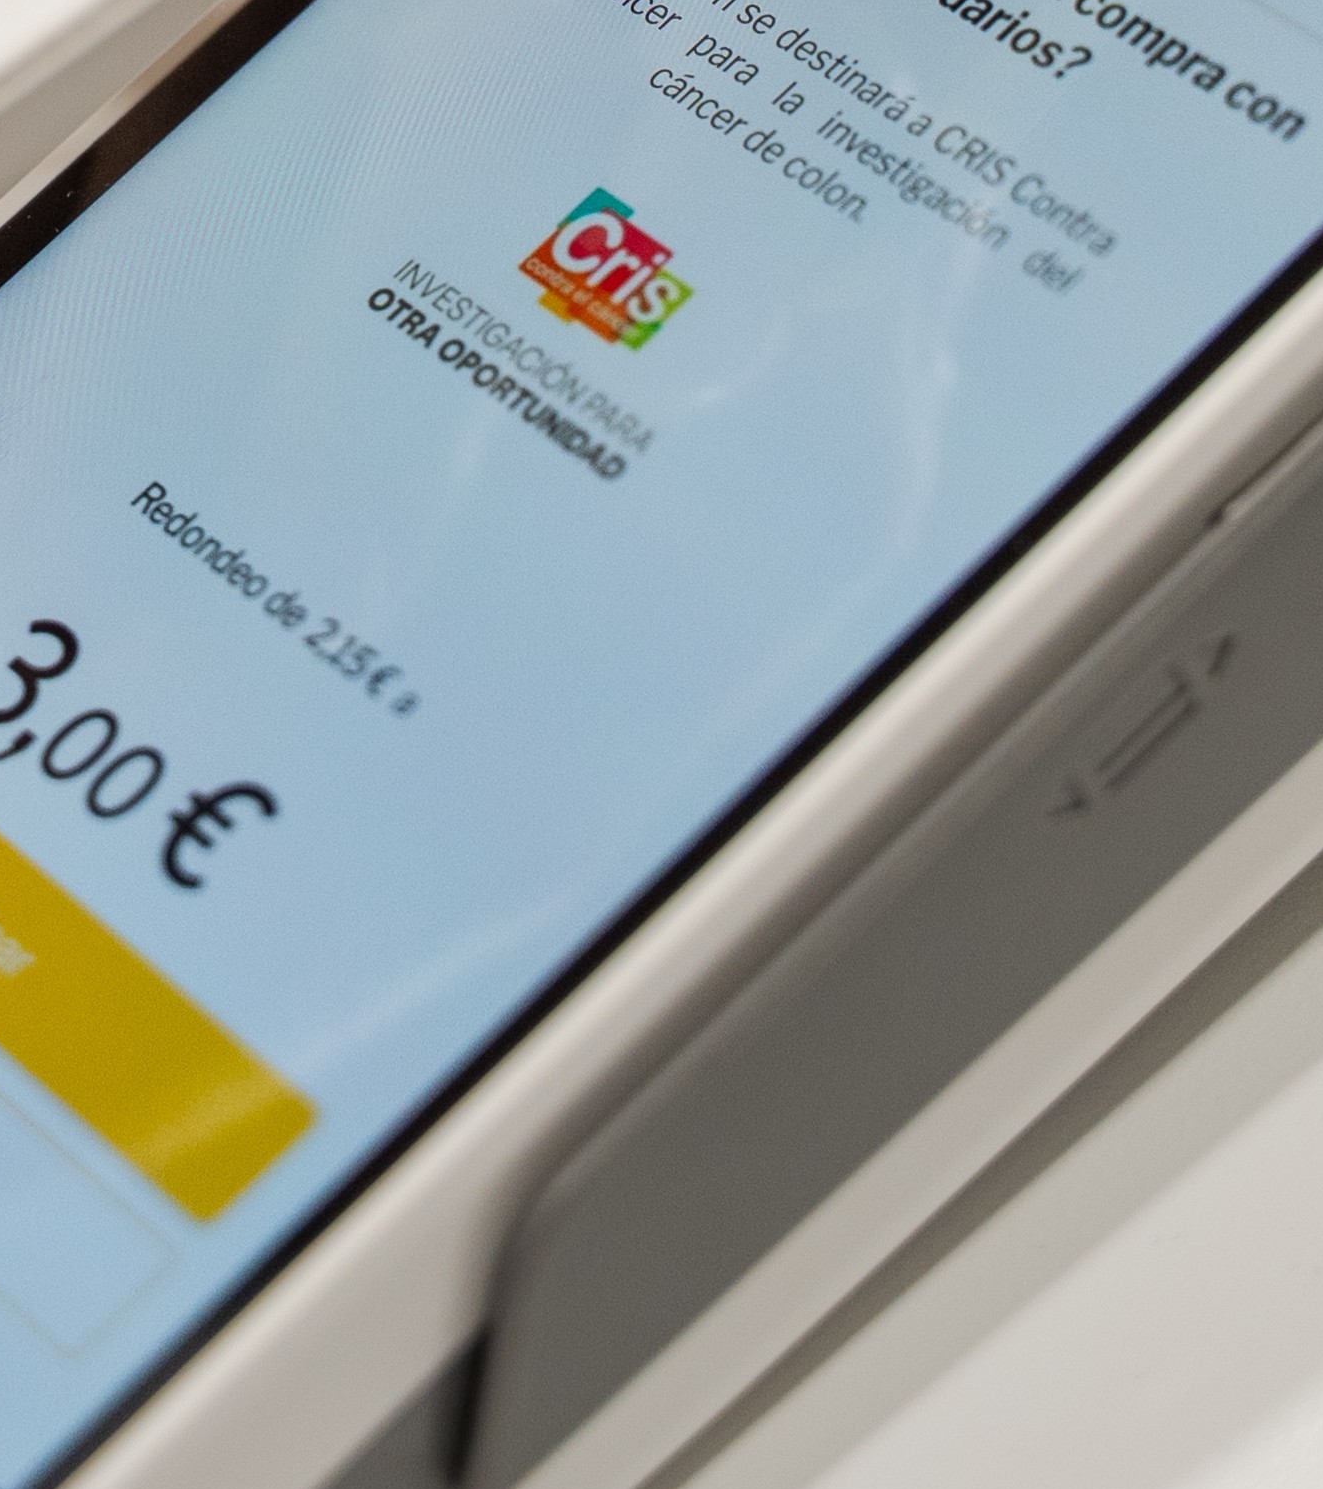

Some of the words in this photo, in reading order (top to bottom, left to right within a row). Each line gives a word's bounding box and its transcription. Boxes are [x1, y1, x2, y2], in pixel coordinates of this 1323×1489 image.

[649, 67, 750, 136] cáncer
[742, 129, 786, 165] de
[685, 34, 760, 86] para
[771, 81, 806, 115] la
[816, 110, 1011, 251] investigación
[1023, 245, 1082, 293] del
[736, 3, 777, 35] se
[775, 27, 917, 123] destinará
[906, 113, 933, 137] a
[933, 124, 1018, 187] CRIS
[1010, 172, 1118, 257] Contra
[1224, 80, 1307, 143] con
[552, 210, 681, 322] Cris
[368, 287, 441, 349] OTRA
[438, 338, 627, 481] OPORTUNIDAD
[393, 258, 590, 406] INVESTIGACIÓN
[584, 391, 655, 456] PARA
[130, 480, 269, 598] Redondeo
[263, 589, 308, 628] de
[160, 780, 281, 890] €
